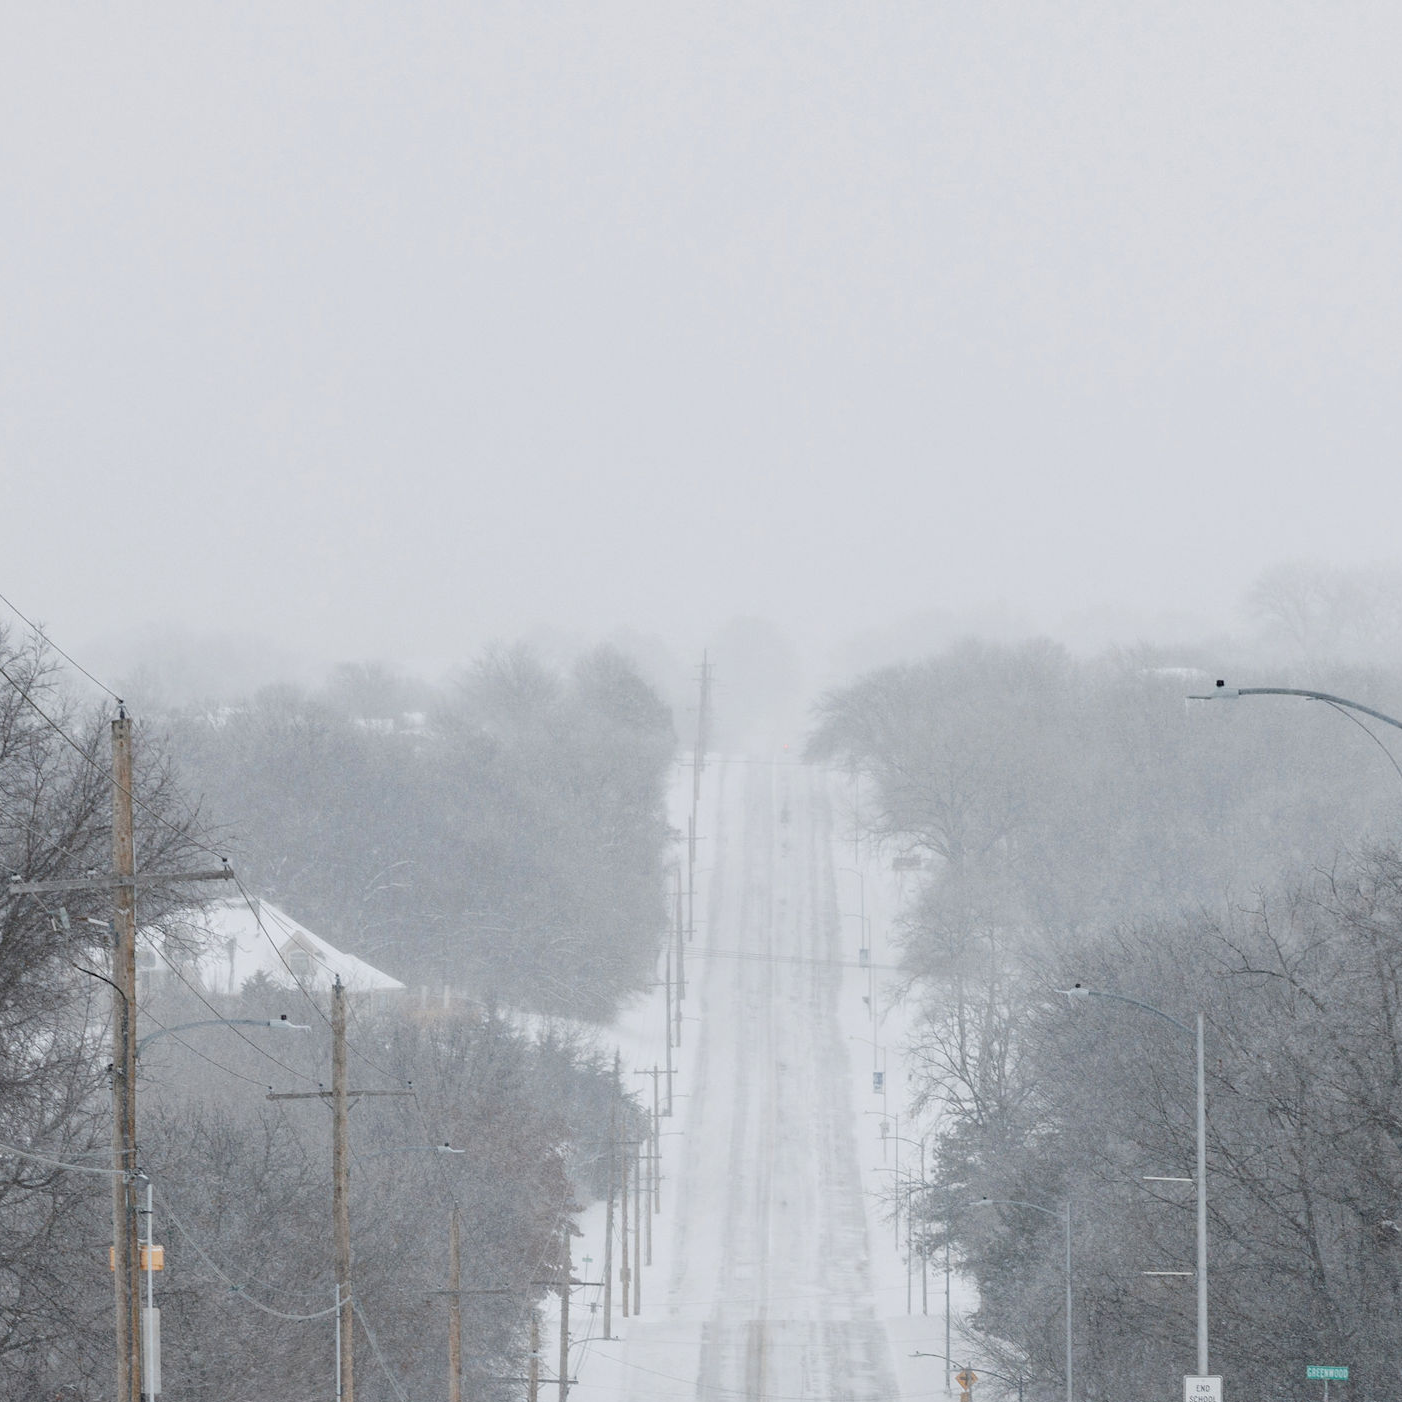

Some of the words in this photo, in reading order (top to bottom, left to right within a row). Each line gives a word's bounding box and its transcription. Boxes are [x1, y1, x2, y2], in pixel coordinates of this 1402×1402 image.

[1307, 1367, 1348, 1378] GREENWOOD
[1196, 1384, 1211, 1392] END
[1189, 1395, 1217, 1402] SCHOOL
